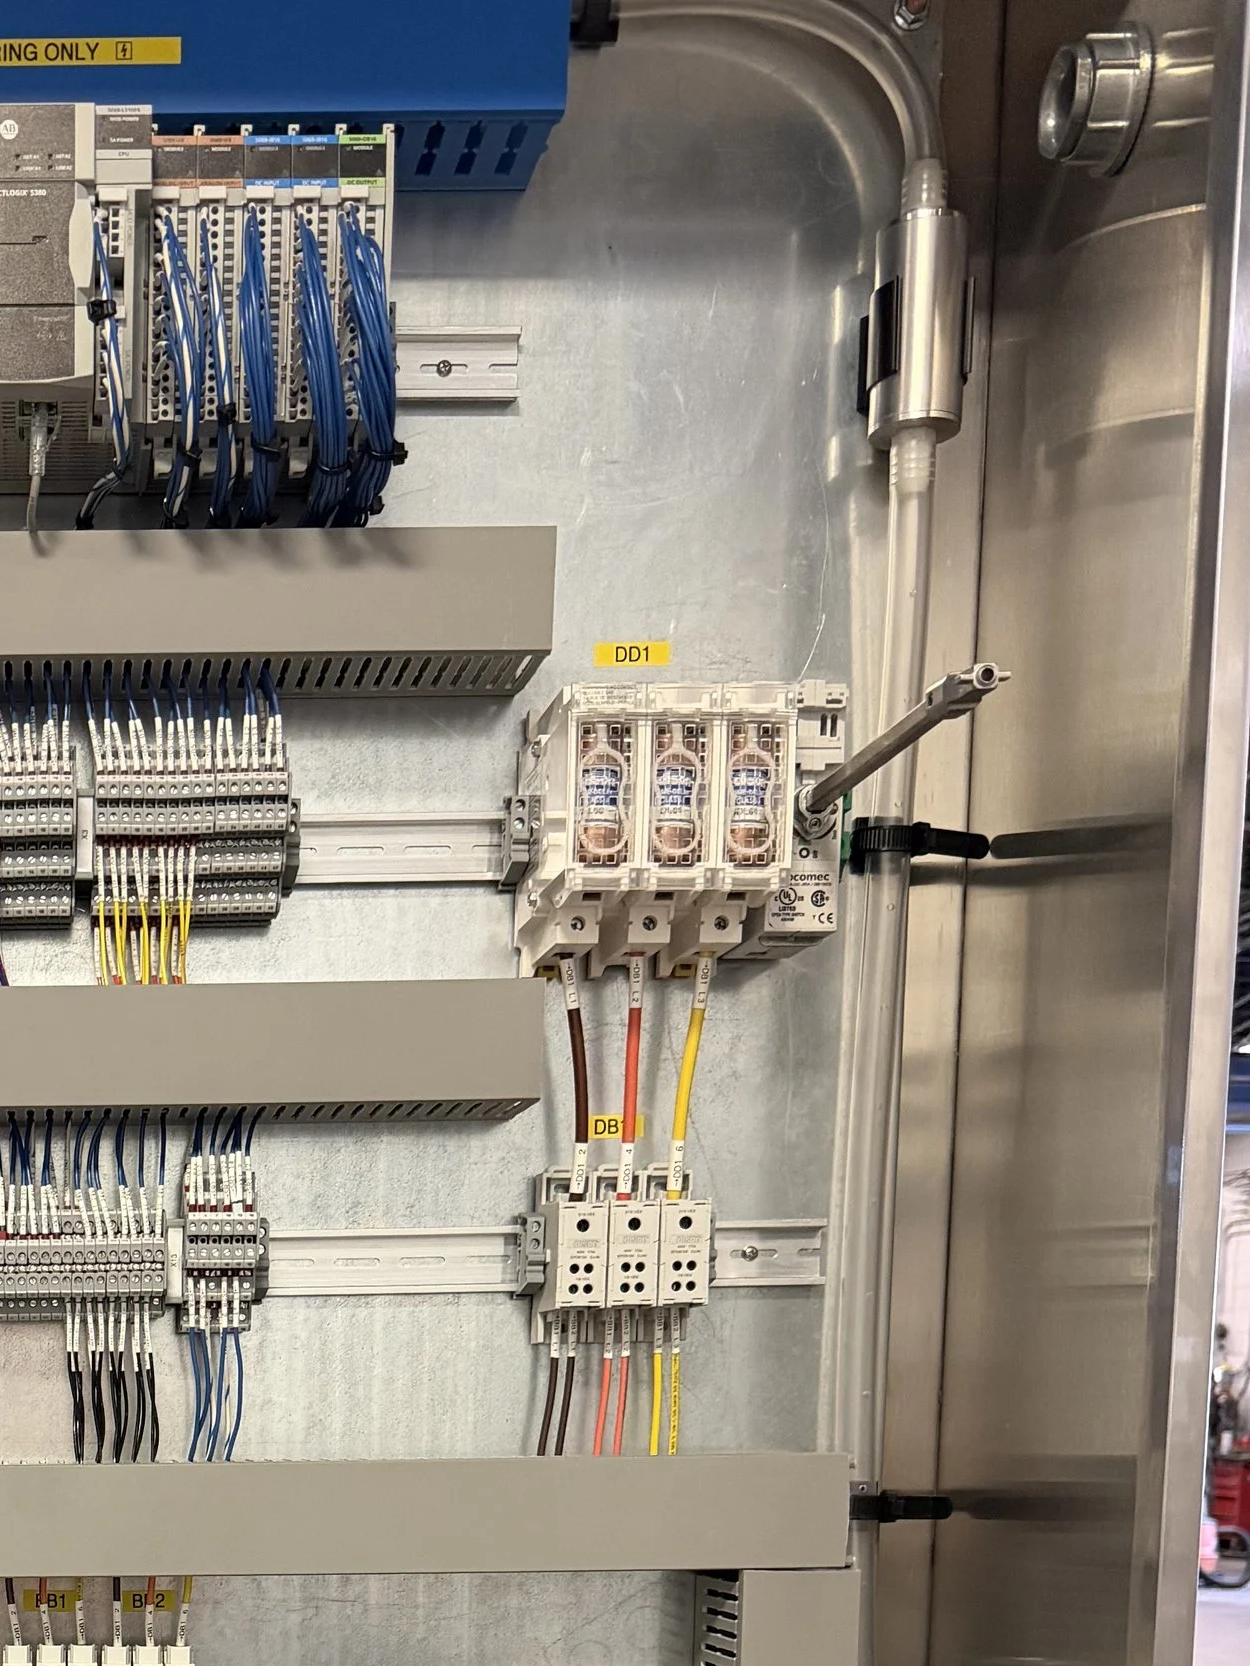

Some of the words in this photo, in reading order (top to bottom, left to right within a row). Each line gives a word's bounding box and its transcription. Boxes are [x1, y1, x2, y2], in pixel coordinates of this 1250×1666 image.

[44, 42, 99, 61] ONLY
[30, 189, 47, 197] 5380
[615, 646, 650, 662] DD1
[790, 873, 830, 881] comec
[632, 966, 641, 984] DB1
[699, 967, 710, 985] DB1
[594, 1119, 624, 1135] DB
[576, 1164, 584, 1182] DD1
[623, 1163, 631, 1181] DD1
[673, 1160, 682, 1178] DD1
[133, 1594, 165, 1608] B2
